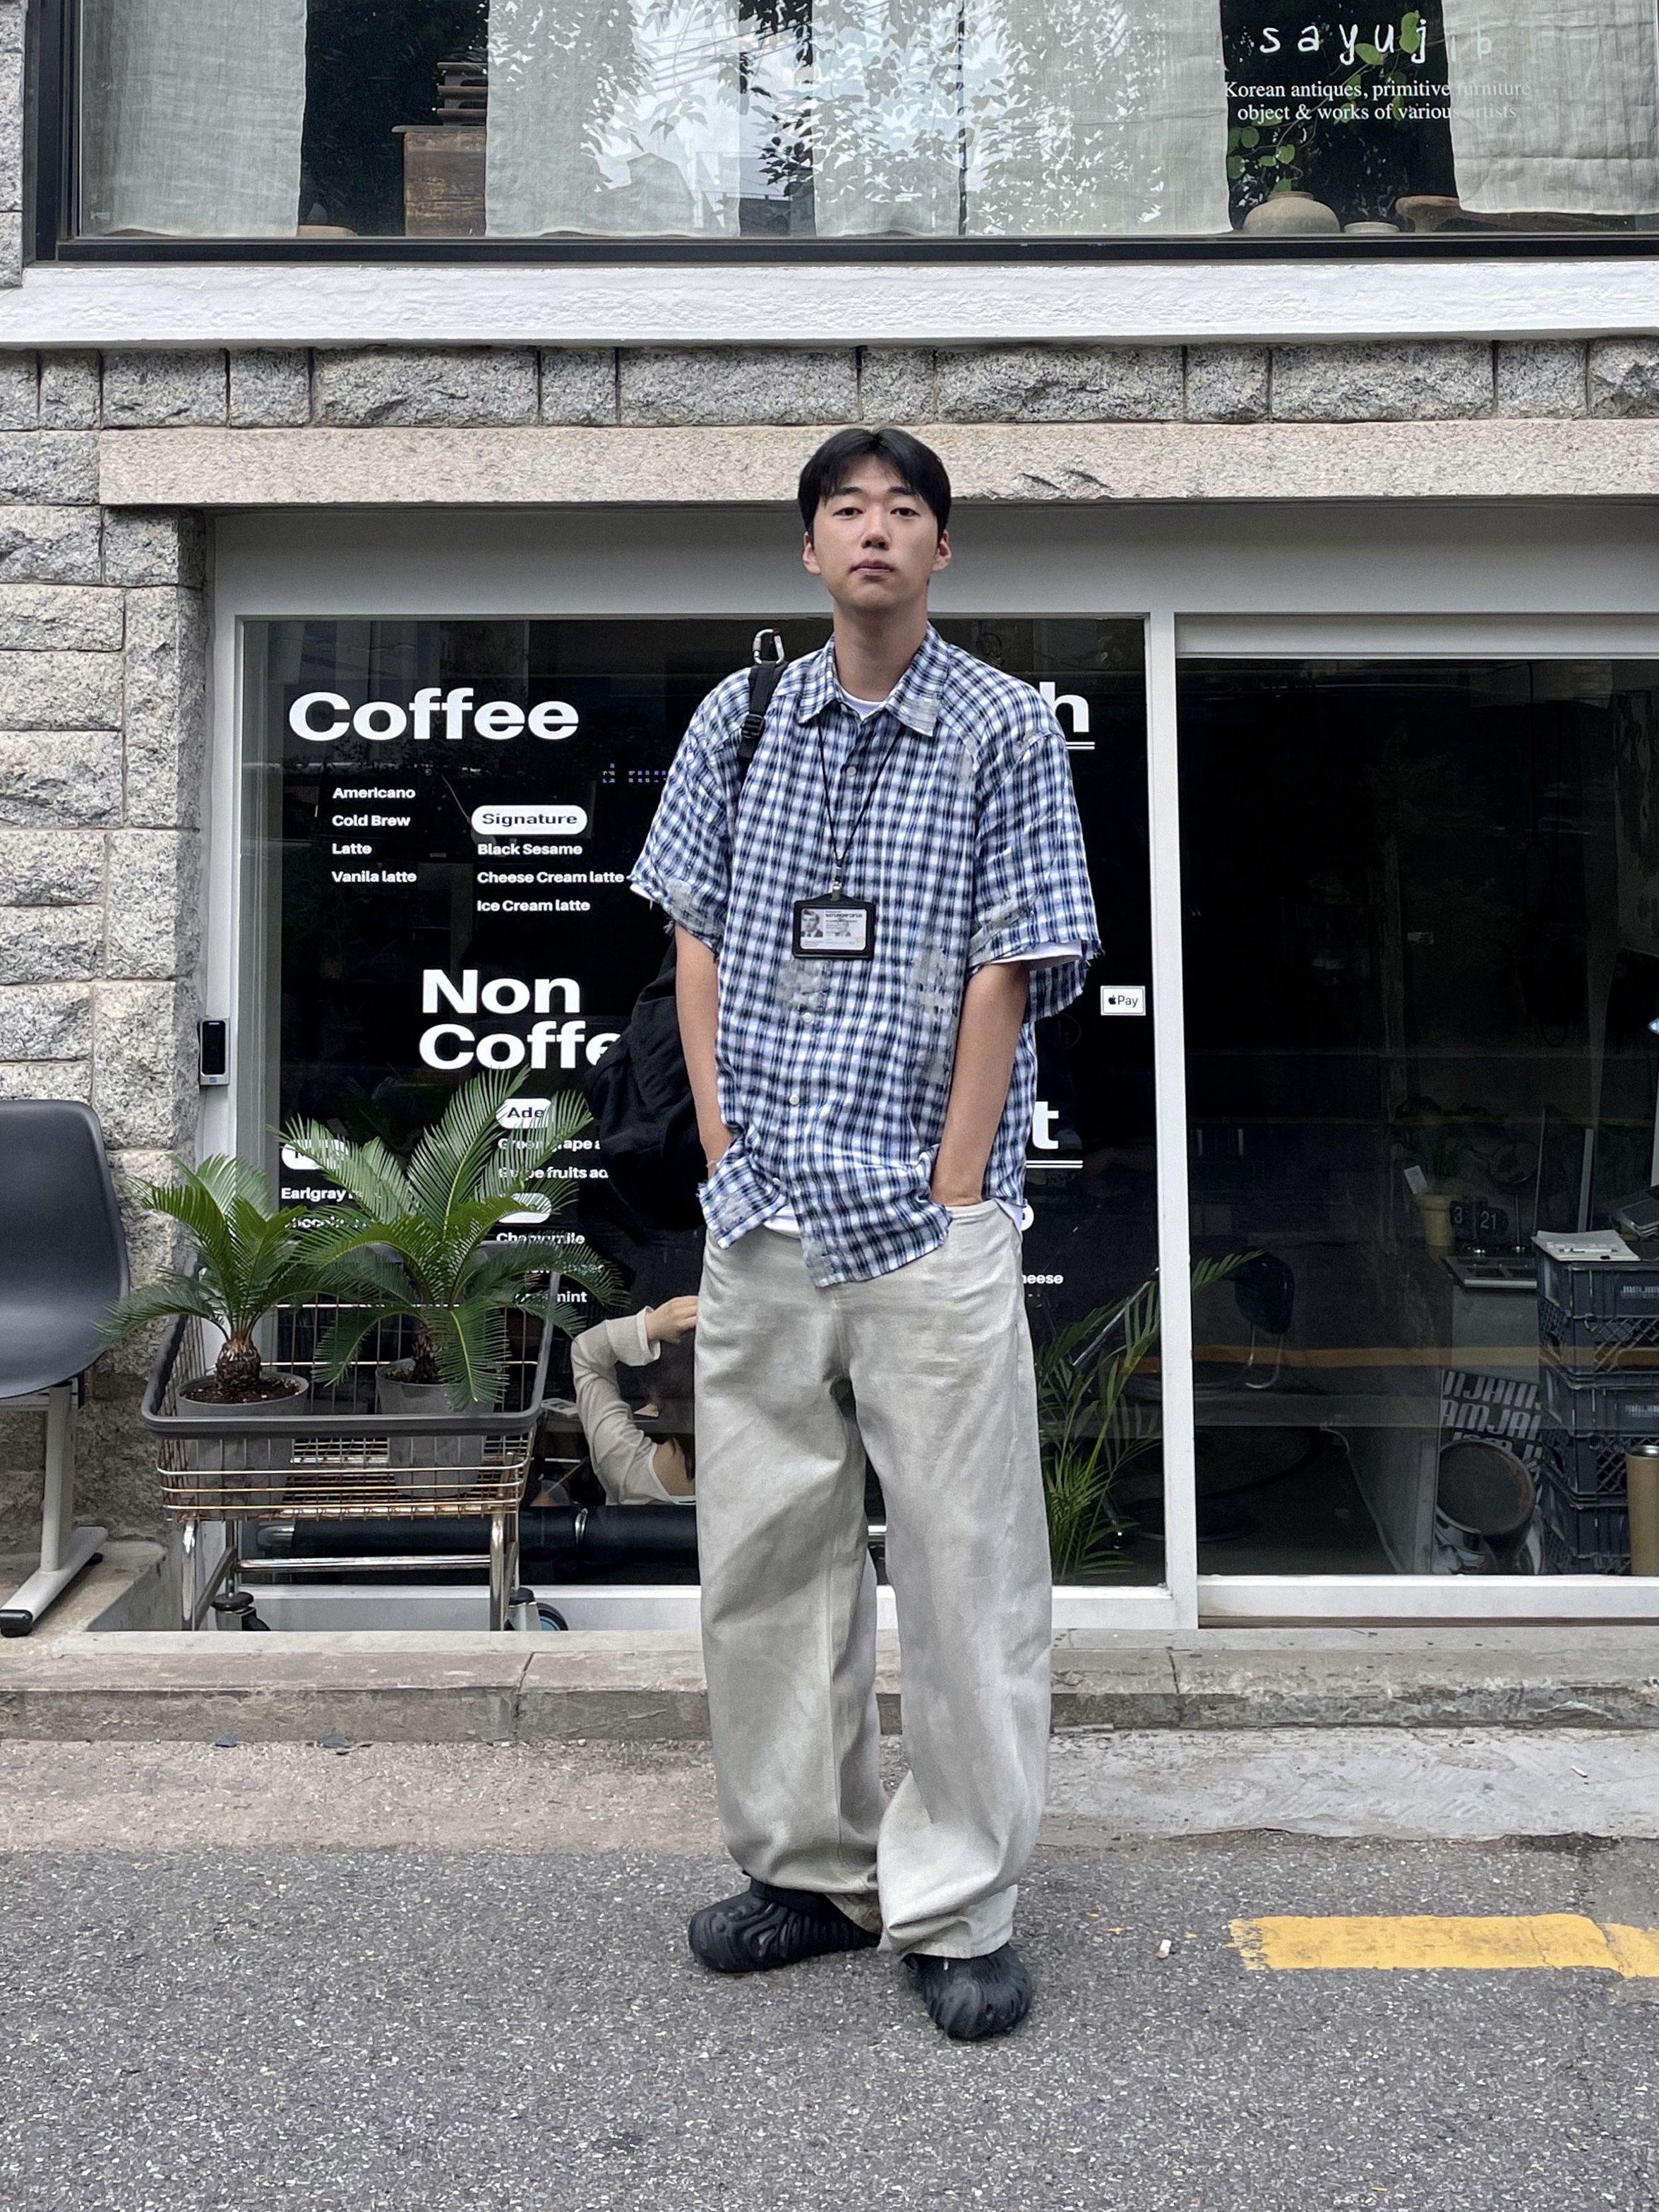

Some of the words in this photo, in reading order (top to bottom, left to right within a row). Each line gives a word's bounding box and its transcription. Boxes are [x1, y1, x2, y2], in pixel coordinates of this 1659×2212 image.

[1225, 81, 1286, 97] Korean
[1290, 80, 1368, 101] antiques,
[1372, 80, 1451, 101] primitive
[1237, 104, 1290, 125] object
[1295, 103, 1312, 121] &
[1317, 104, 1370, 121] works
[1374, 103, 1394, 120] of
[1399, 103, 1461, 120] various
[289, 687, 579, 741] Coffee
[332, 787, 416, 800] Americano
[332, 814, 369, 827] Cold
[371, 815, 411, 827] Brew
[482, 813, 578, 827] Signature
[332, 842, 373, 855] Latte
[477, 842, 521, 856] Black
[522, 843, 583, 856] Sesame
[331, 870, 380, 883] Vanila
[381, 870, 417, 883] latte
[477, 871, 534, 884] Cheese
[536, 871, 588, 884] Cream
[589, 871, 625, 884] latte
[477, 899, 501, 912] Ice
[502, 899, 553, 912] Cream
[555, 899, 591, 912] latte
[422, 969, 580, 1015] Non
[1117, 994, 1139, 1008] Pay
[419, 1020, 622, 1070] Coffe
[507, 1106, 546, 1119] Ade
[280, 1187, 347, 1202] Earlgray
[1480, 1210, 1497, 1231] 21
